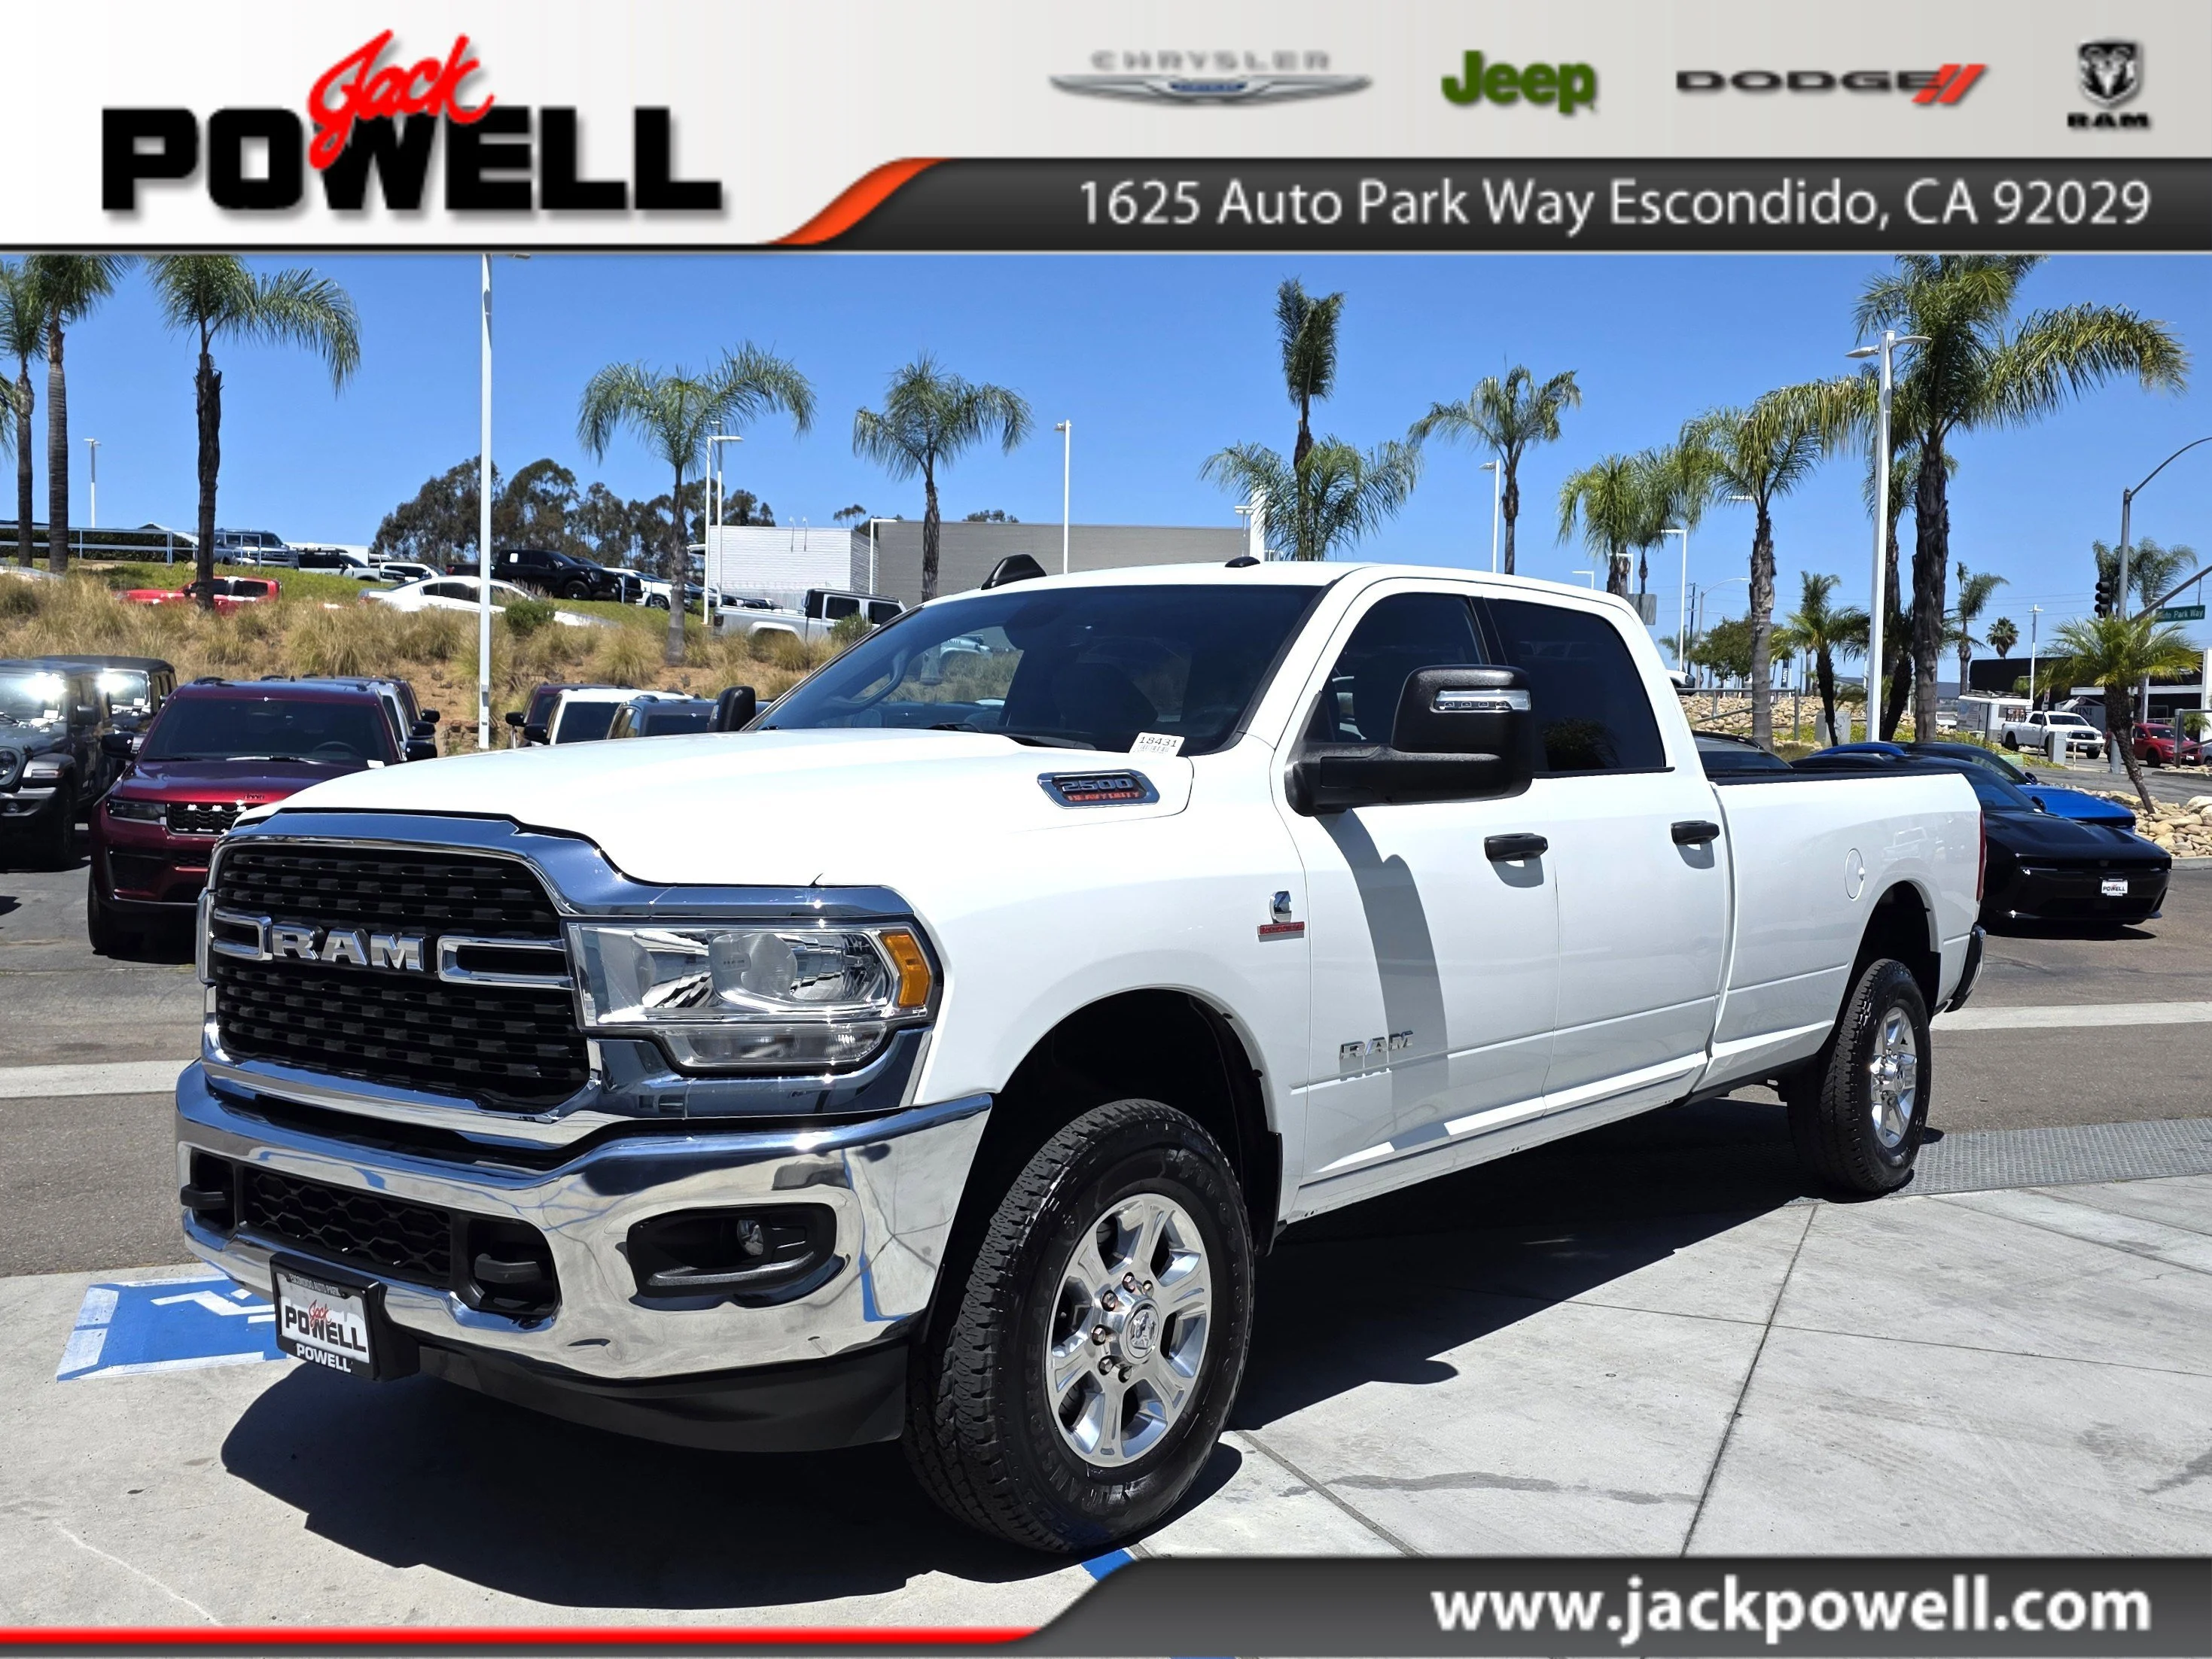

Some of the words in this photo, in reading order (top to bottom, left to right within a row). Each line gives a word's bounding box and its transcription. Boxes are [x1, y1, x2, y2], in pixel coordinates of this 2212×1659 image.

[2174, 610, 2188, 619] Park
[2190, 609, 2204, 618] Way
[1139, 736, 1177, 747] 18431
[1060, 778, 1133, 792] 2500
[272, 921, 428, 973] RAM
[1339, 1030, 1413, 1060] RAM
[285, 1305, 367, 1353] POWELL
[308, 1299, 332, 1329] Jack
[296, 1342, 352, 1373] POWELL
